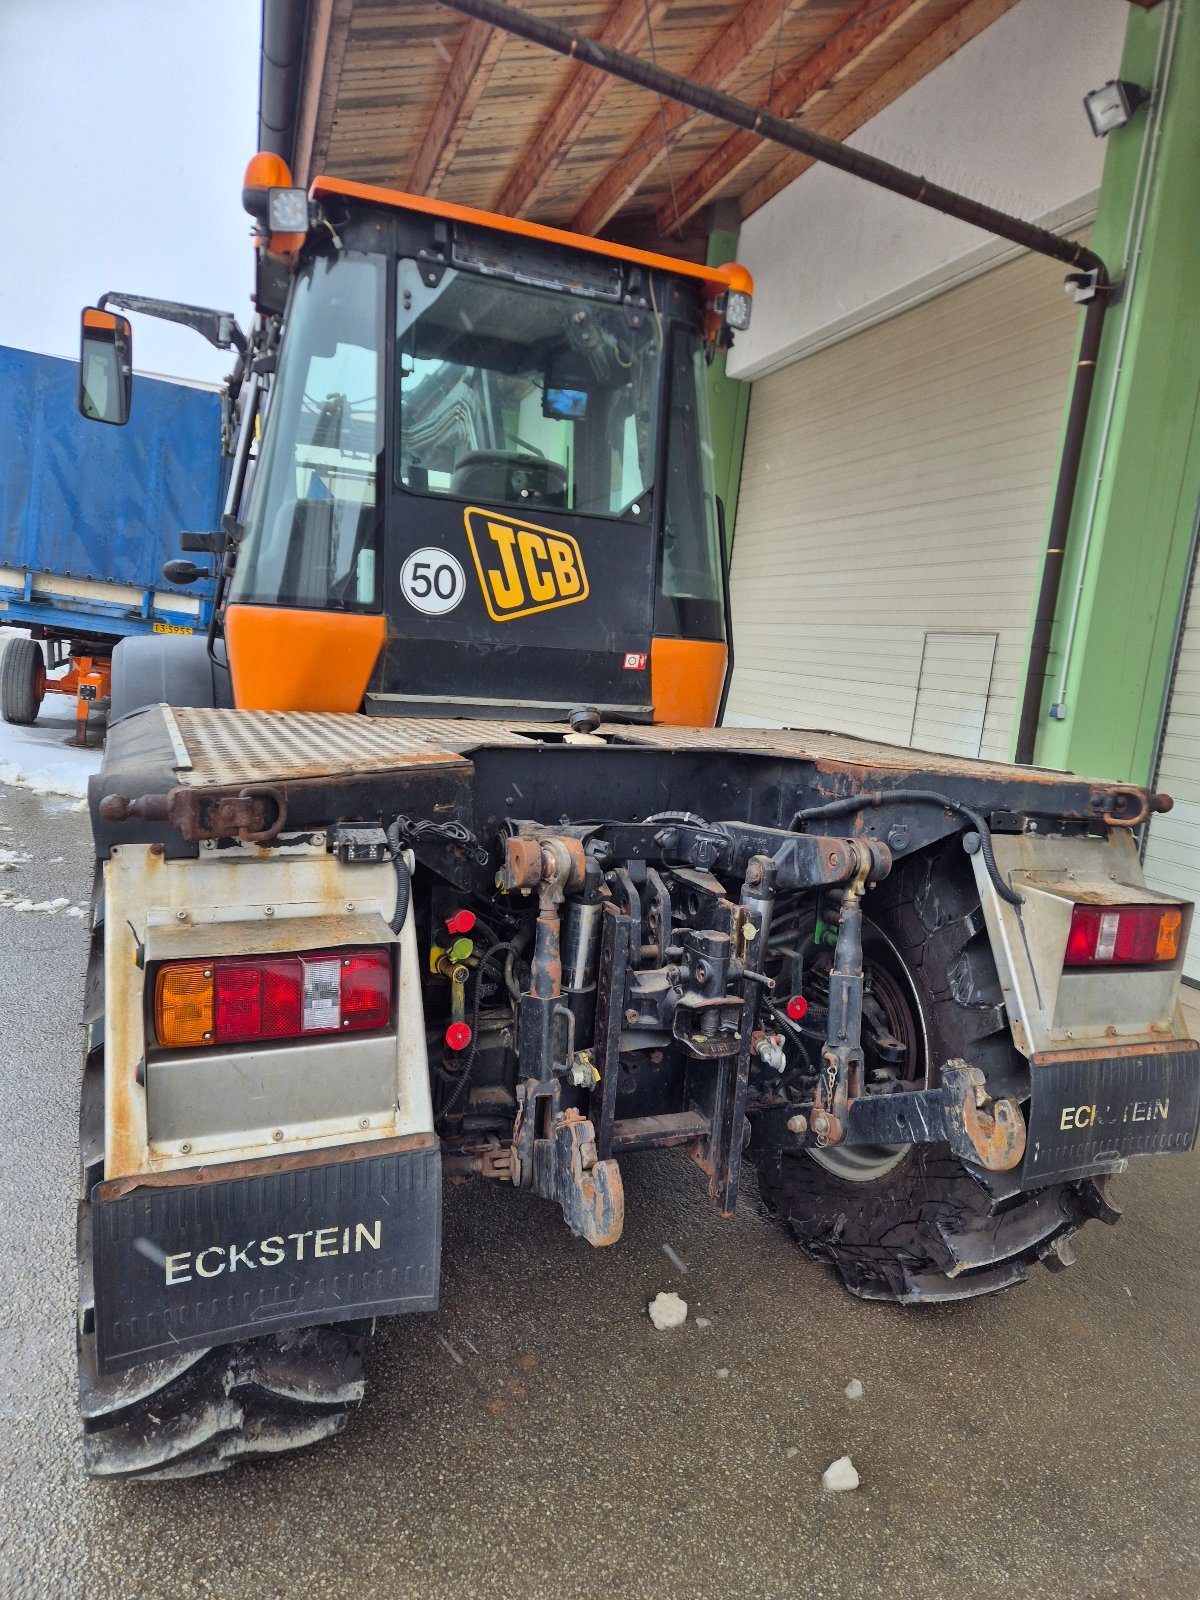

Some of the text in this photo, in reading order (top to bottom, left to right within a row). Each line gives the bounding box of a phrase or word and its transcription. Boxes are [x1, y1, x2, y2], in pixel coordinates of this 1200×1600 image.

[410, 562, 457, 600] 50
[487, 521, 581, 609] JCB
[164, 1220, 382, 1286] ECKSTEIN
